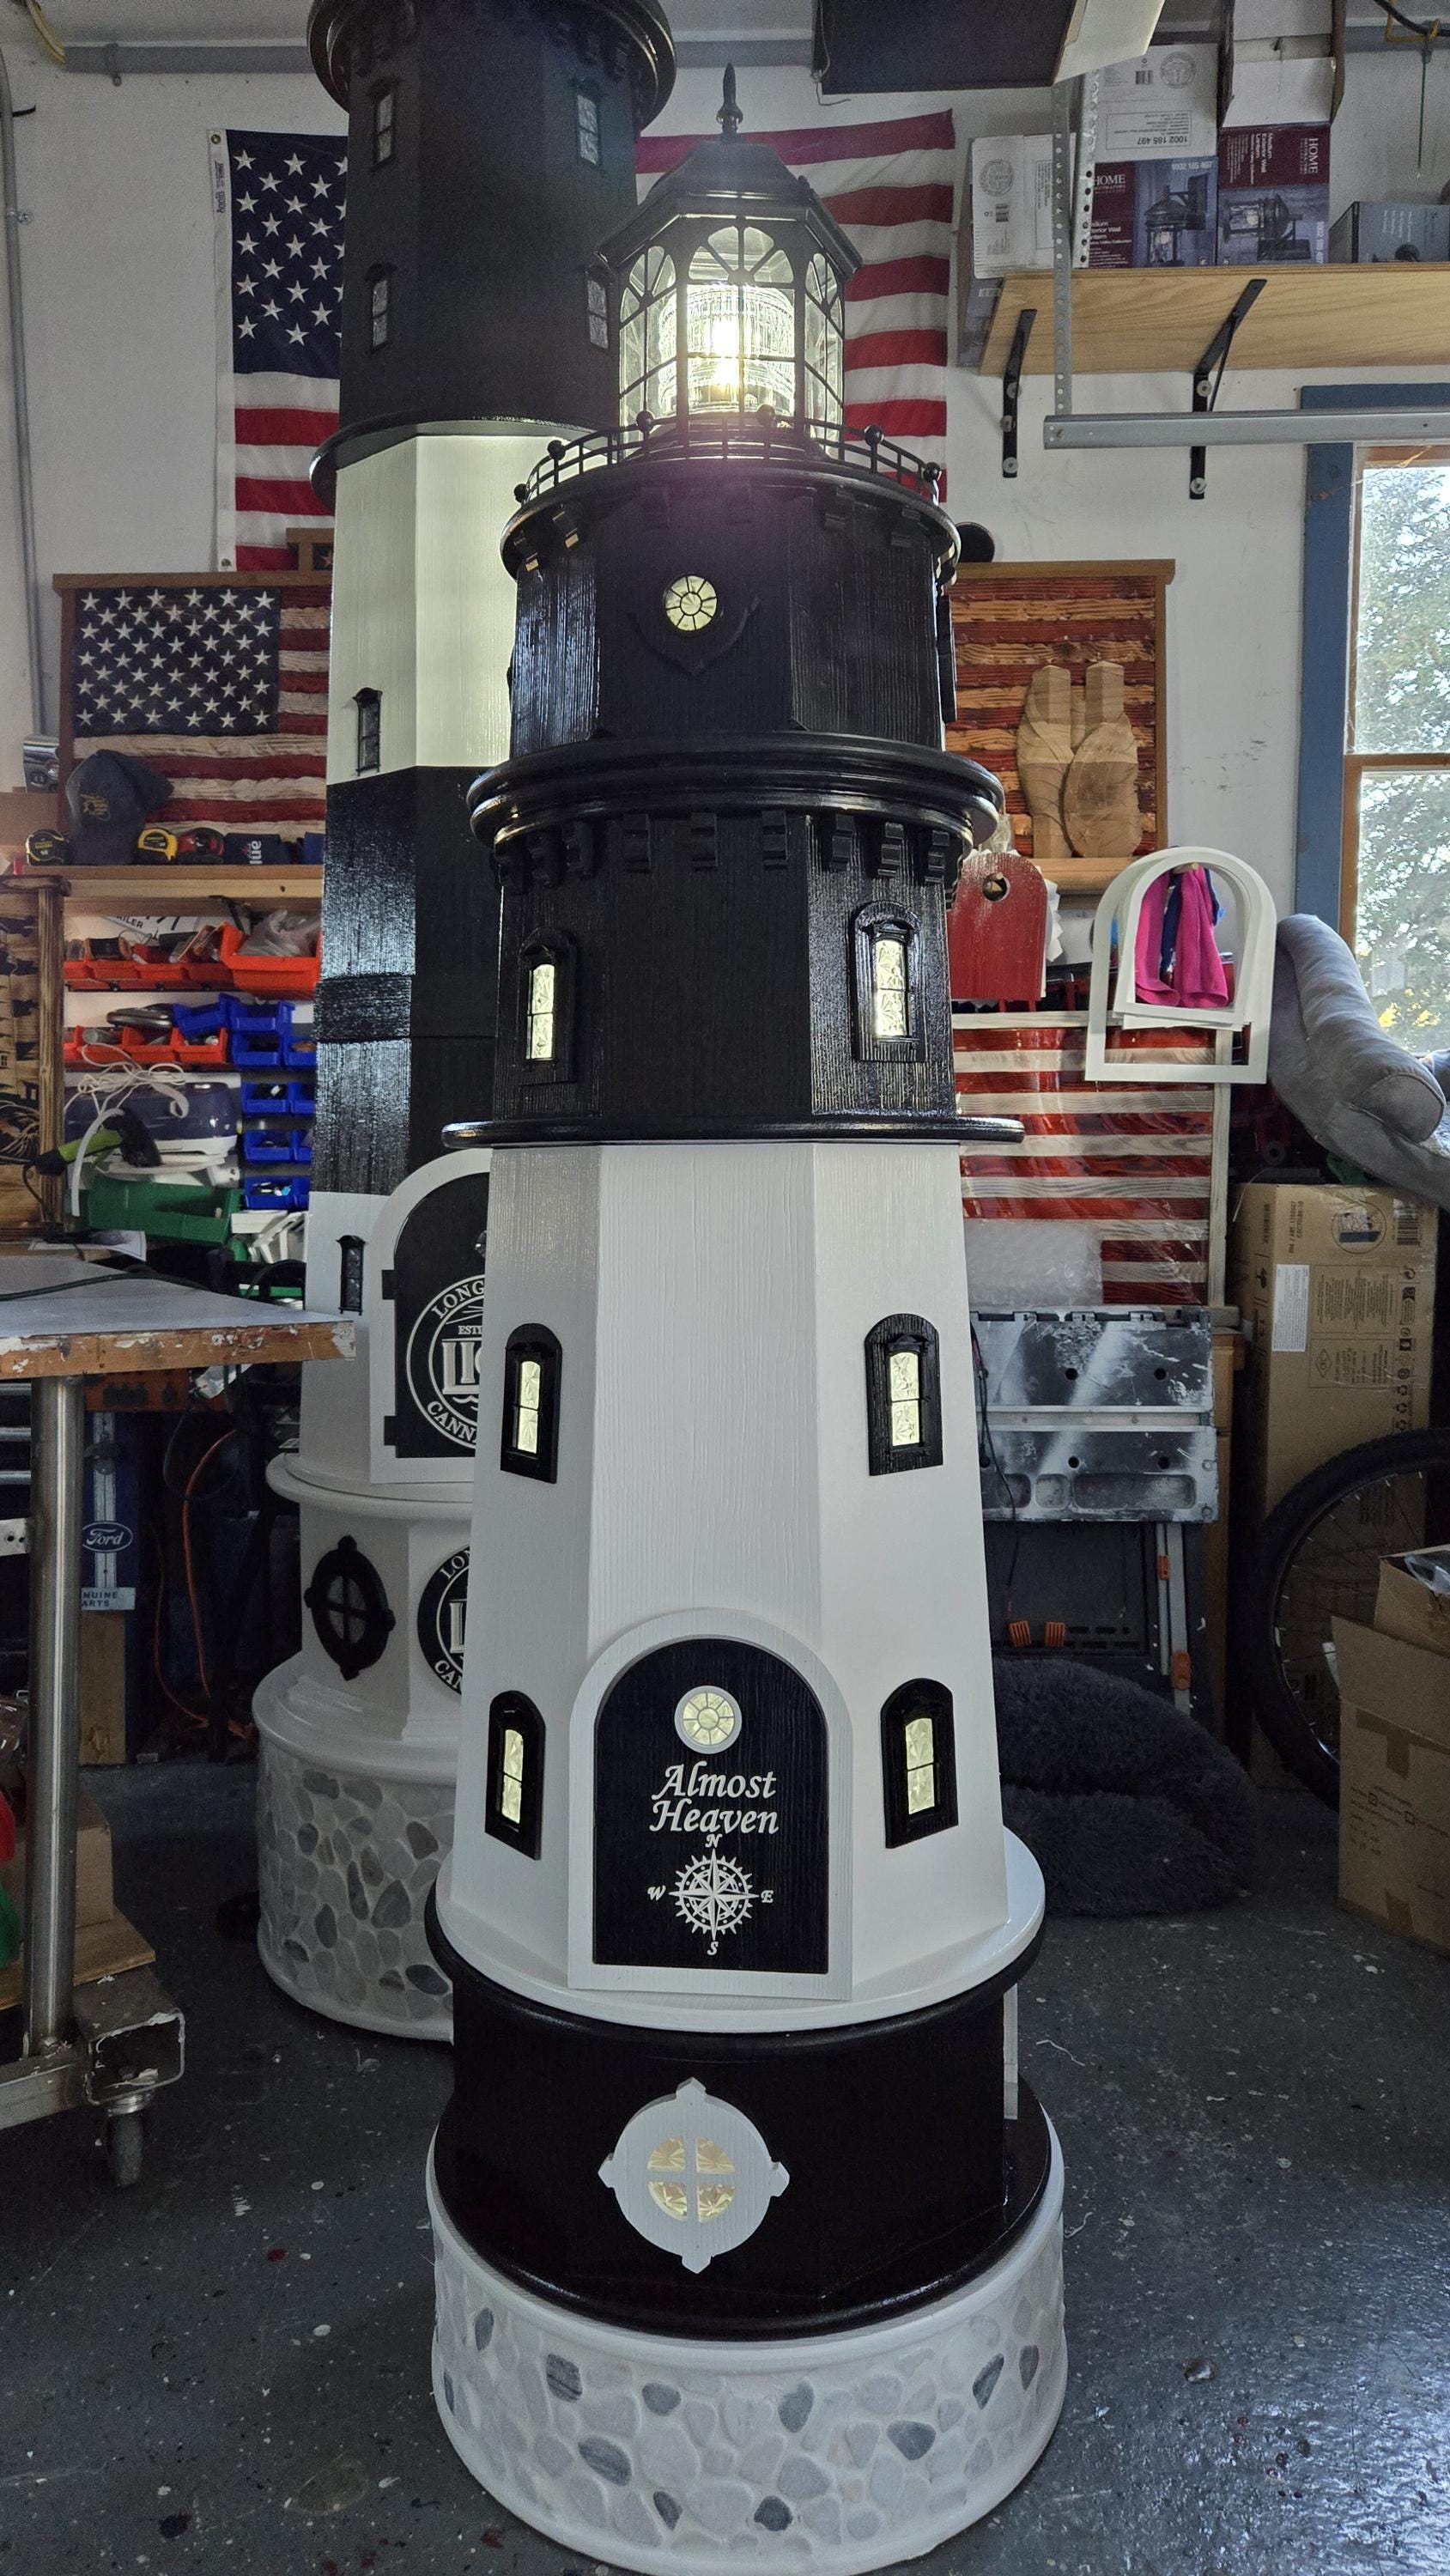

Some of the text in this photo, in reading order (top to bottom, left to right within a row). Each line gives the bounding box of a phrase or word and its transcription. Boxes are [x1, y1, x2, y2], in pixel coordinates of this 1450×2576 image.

[1309, 138, 1319, 173] HOME
[250, 841, 263, 865] lue
[432, 1280, 484, 1319] LONG
[428, 1401, 477, 1443] CANN
[87, 1528, 124, 1546] Ford
[652, 1761, 777, 1801] Almost
[649, 1798, 779, 1834] Heaven
[705, 1833, 723, 1848] N
[647, 1885, 666, 1901] W
[761, 1890, 774, 1903] E
[707, 1941, 719, 1955] S
